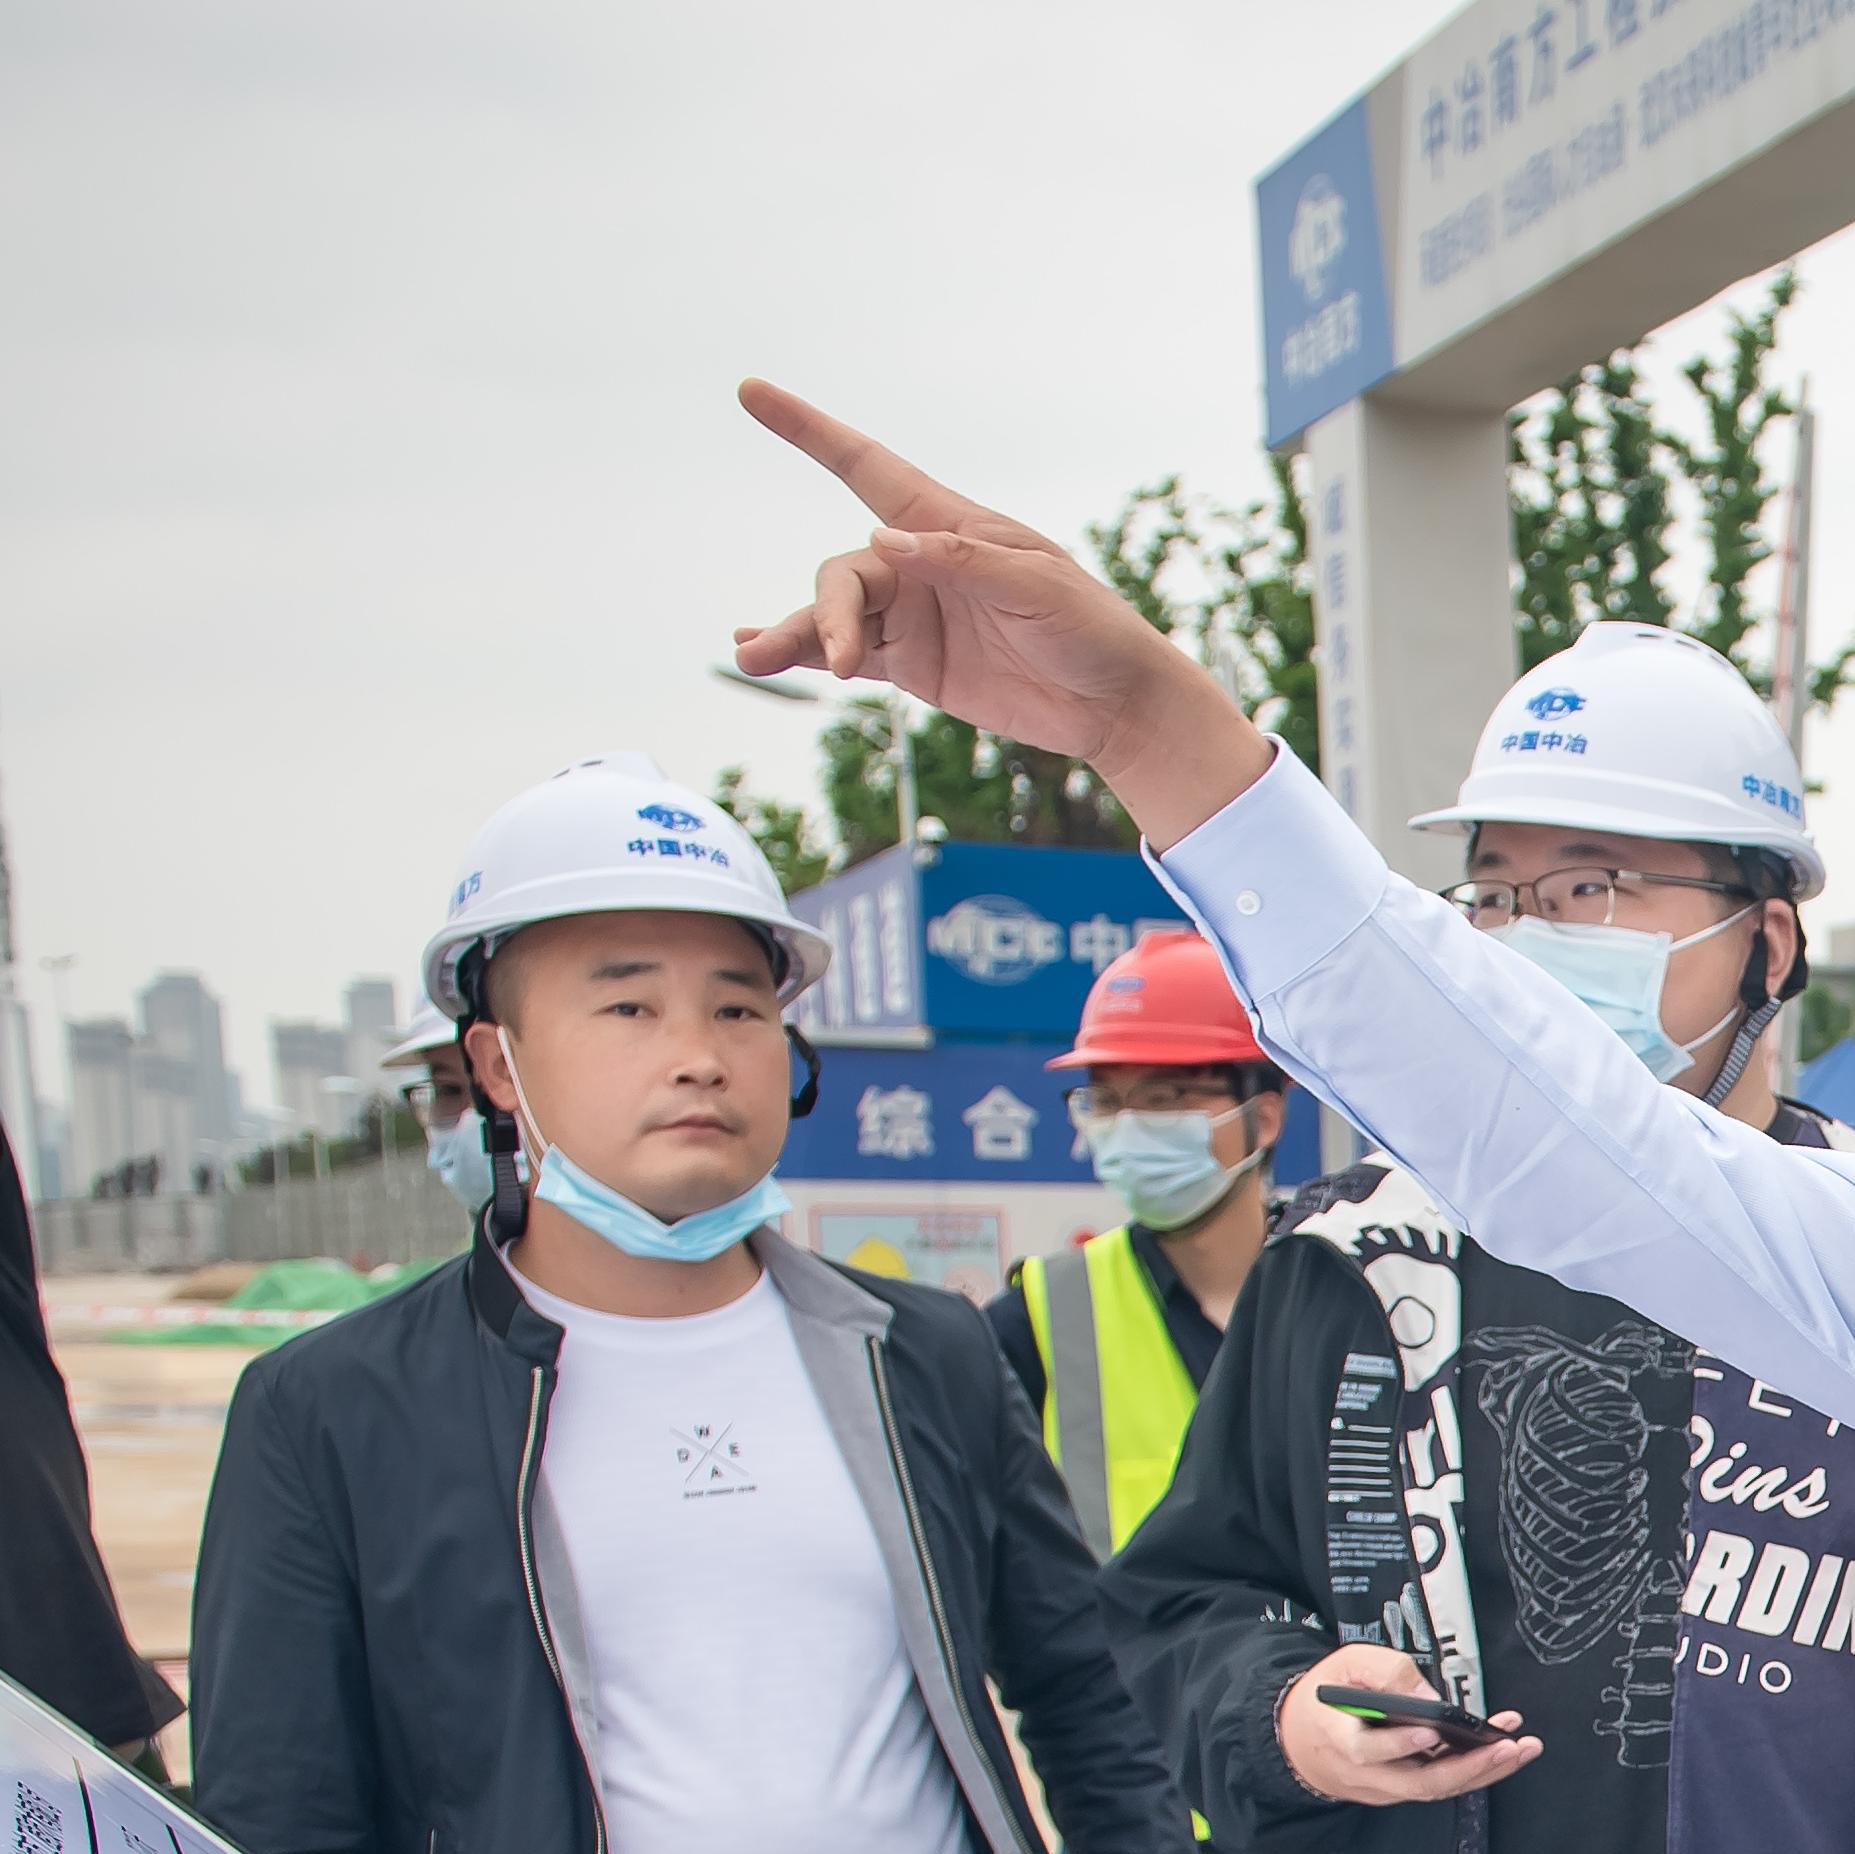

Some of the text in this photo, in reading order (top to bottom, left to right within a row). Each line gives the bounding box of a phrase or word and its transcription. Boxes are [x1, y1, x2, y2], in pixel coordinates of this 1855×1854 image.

[1500, 730, 1589, 755] 中国中冶
[627, 837, 730, 868] 中国中冶
